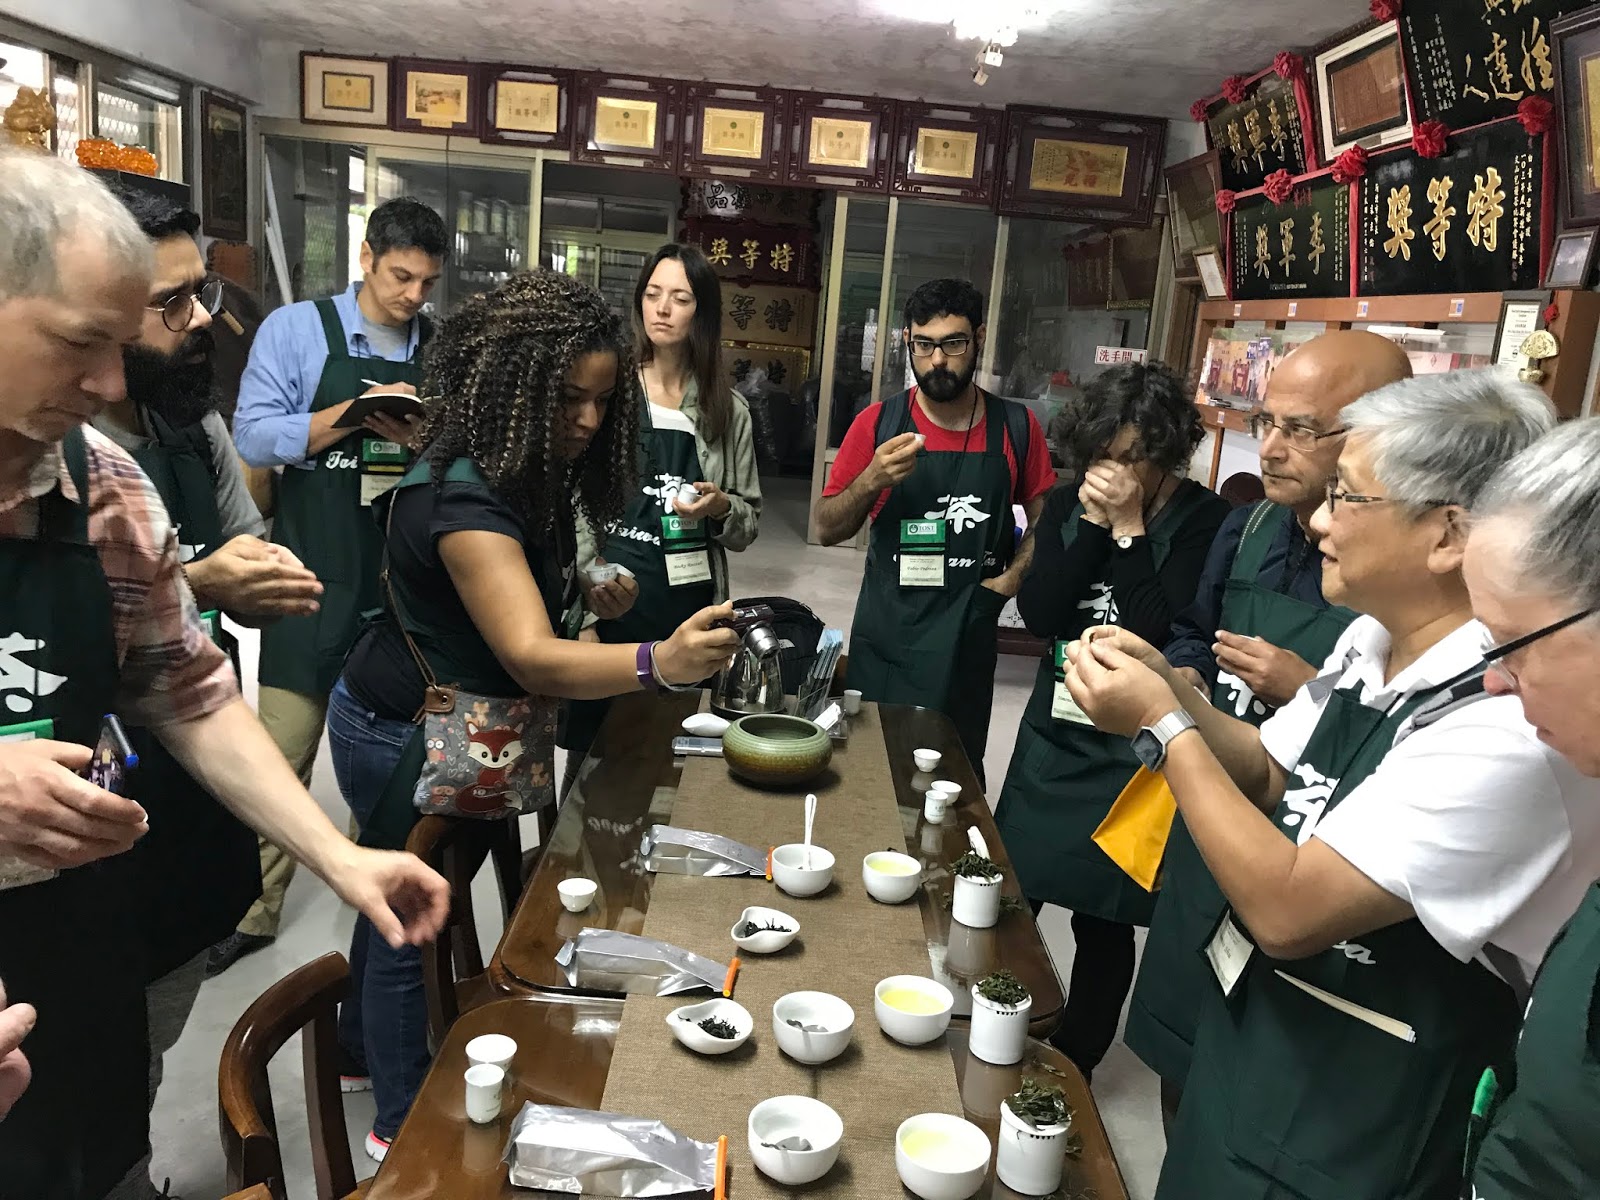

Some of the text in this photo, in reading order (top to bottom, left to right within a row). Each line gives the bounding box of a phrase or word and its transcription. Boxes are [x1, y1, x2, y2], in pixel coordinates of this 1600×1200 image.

[1383, 166, 1506, 263] 特等獎
[706, 237, 795, 272] 特等獎
[729, 293, 795, 332] 特等
[1099, 349, 1132, 362] 洗手間
[325, 450, 358, 470] Tai
